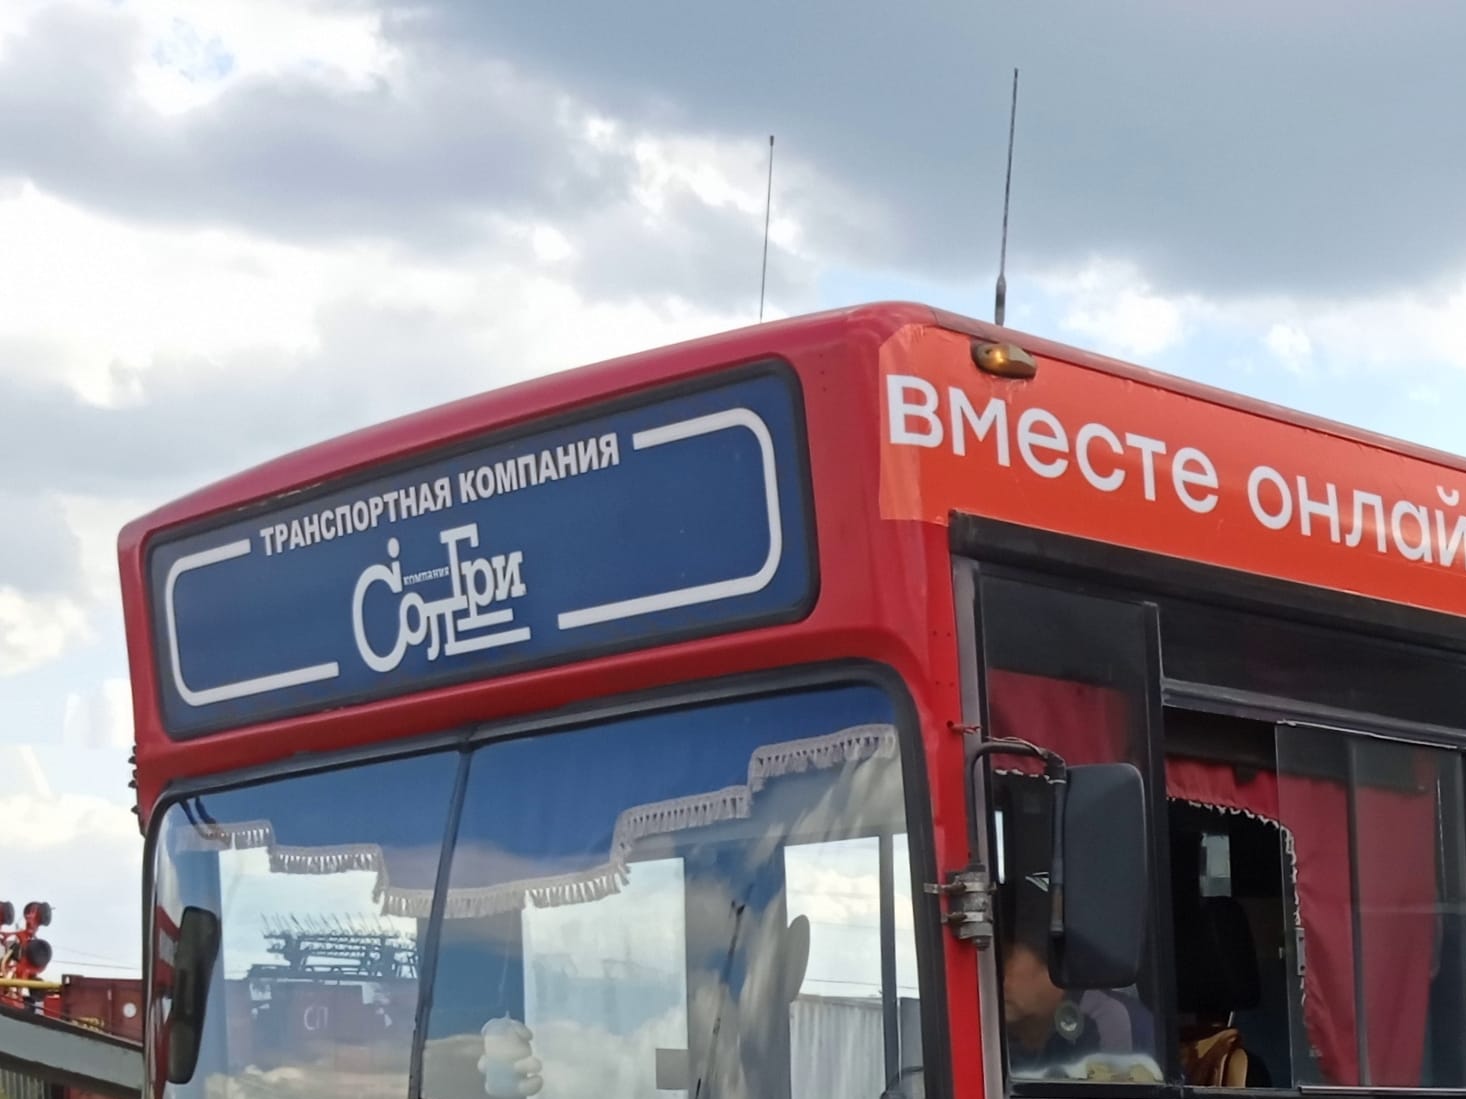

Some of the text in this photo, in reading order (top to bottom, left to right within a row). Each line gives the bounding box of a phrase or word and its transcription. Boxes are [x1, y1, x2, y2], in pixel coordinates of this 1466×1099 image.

[260, 432, 621, 557] ТРАНСПОРТНАЯ КОМПАНИЯ
[403, 566, 450, 586] компания
